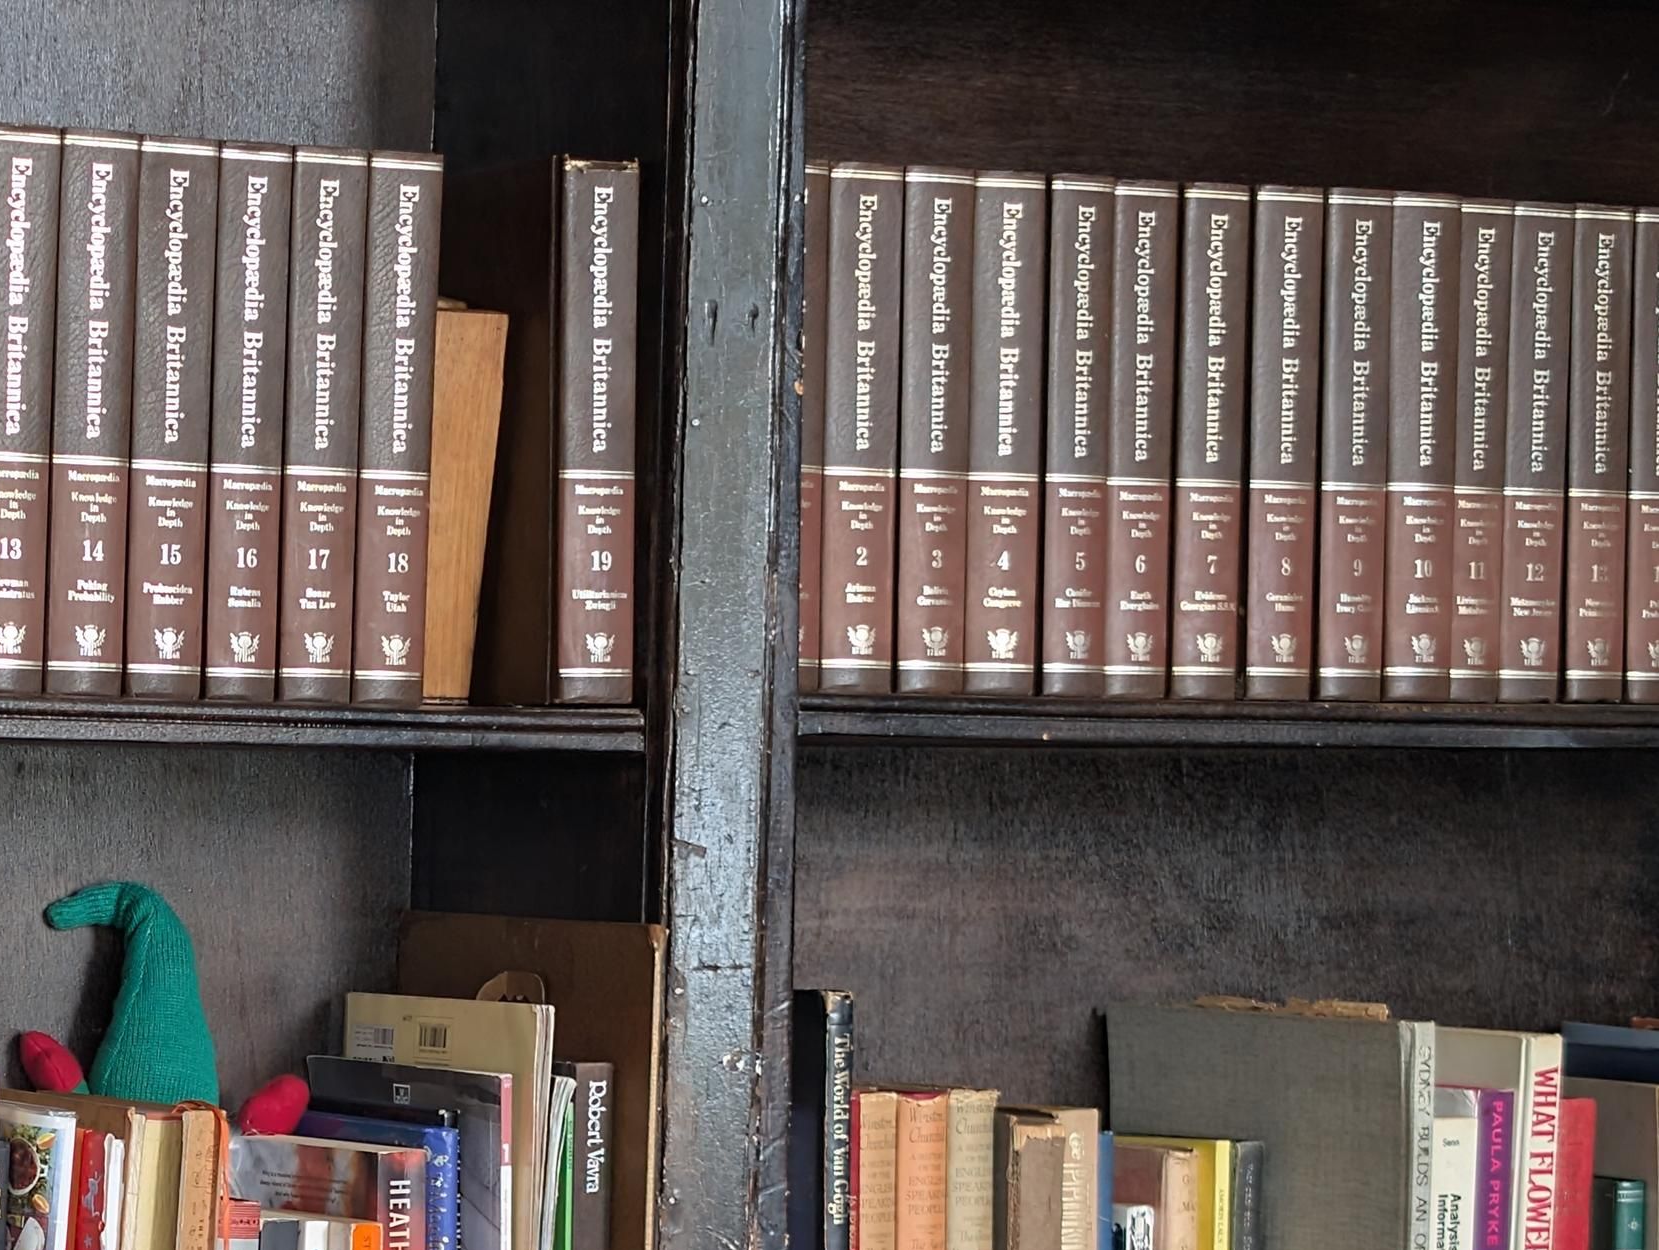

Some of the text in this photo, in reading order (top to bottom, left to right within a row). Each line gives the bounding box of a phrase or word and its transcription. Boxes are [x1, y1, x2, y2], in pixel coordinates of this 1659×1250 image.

[5, 316, 29, 434] Britannica
[592, 338, 613, 453] Britannica
[998, 347, 1020, 457] Britannica
[1419, 361, 1440, 467] Britannica
[0, 539, 22, 560] 13
[591, 551, 612, 571] 19
[997, 551, 1010, 571] 4
[1414, 559, 1433, 579] 10
[585, 1080, 607, 1194] Robert Vavra
[1531, 1066, 1559, 1142] WHAT
[1486, 1101, 1503, 1247] PAULA PRYKE
